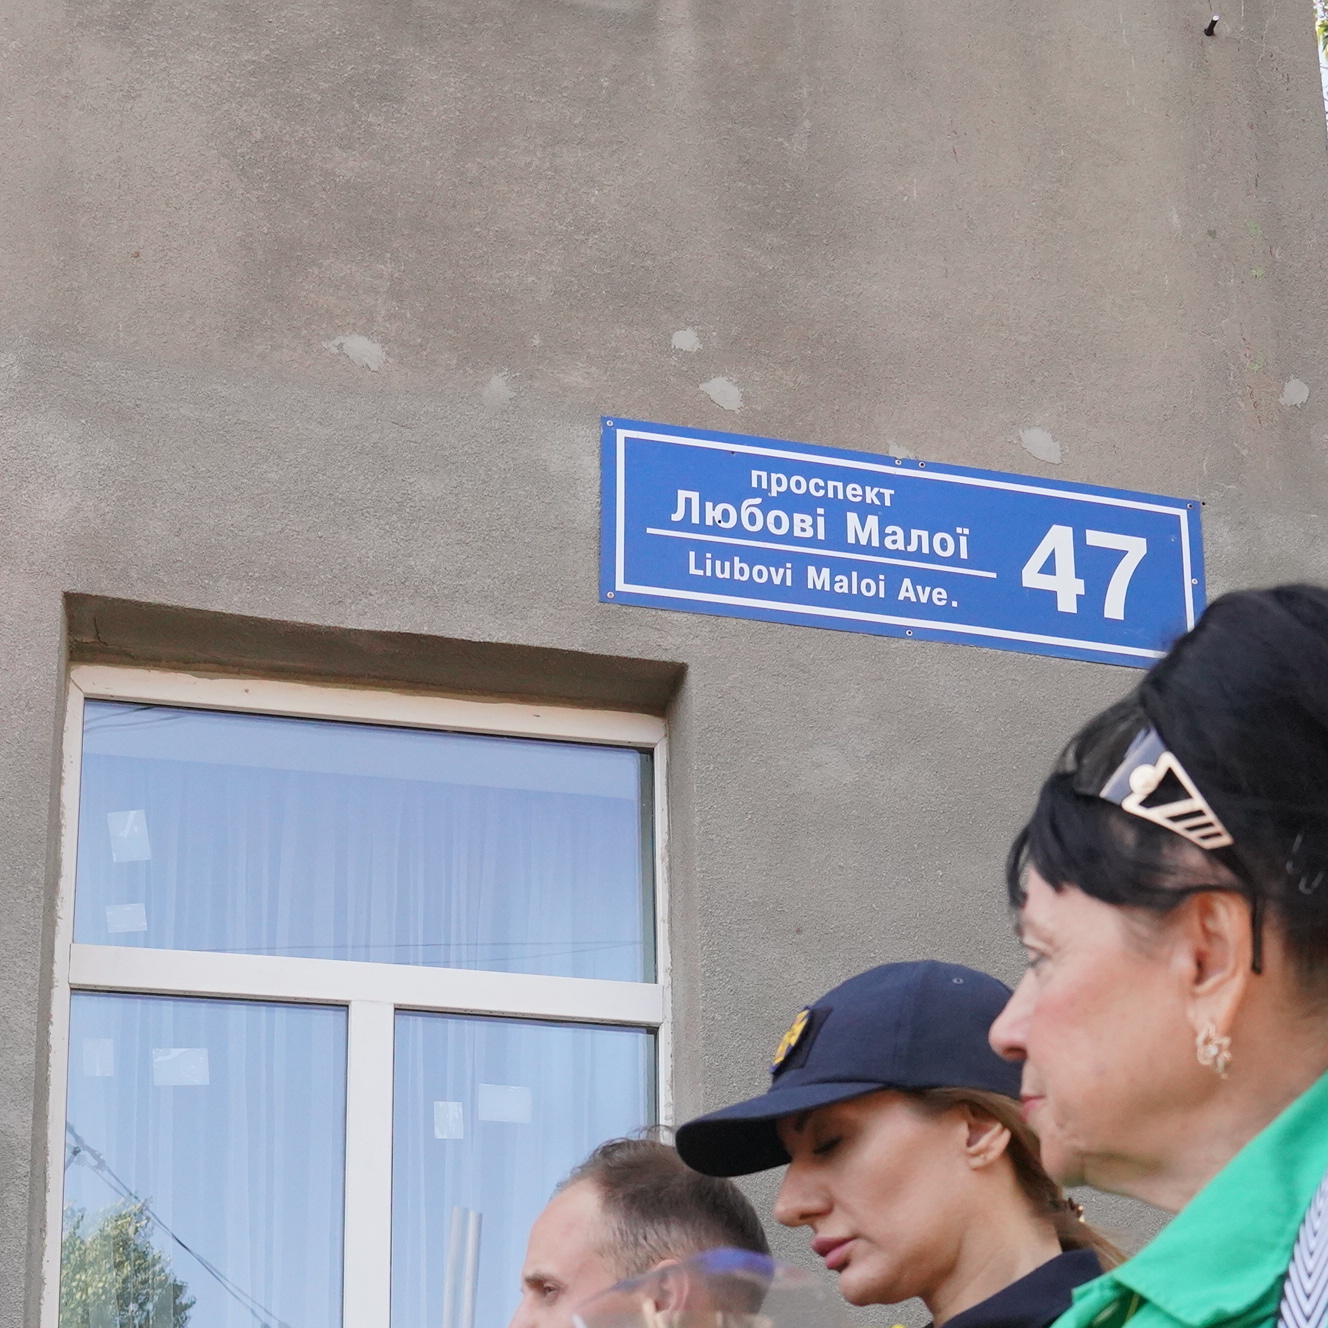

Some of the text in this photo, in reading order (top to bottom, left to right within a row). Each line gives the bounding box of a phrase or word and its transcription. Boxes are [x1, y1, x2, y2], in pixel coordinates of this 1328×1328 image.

[751, 469, 895, 507] проспект
[670, 489, 970, 560] Любові Малої
[688, 550, 958, 608] Liubovi Maloi Ave.
[1021, 523, 1148, 621] 47
